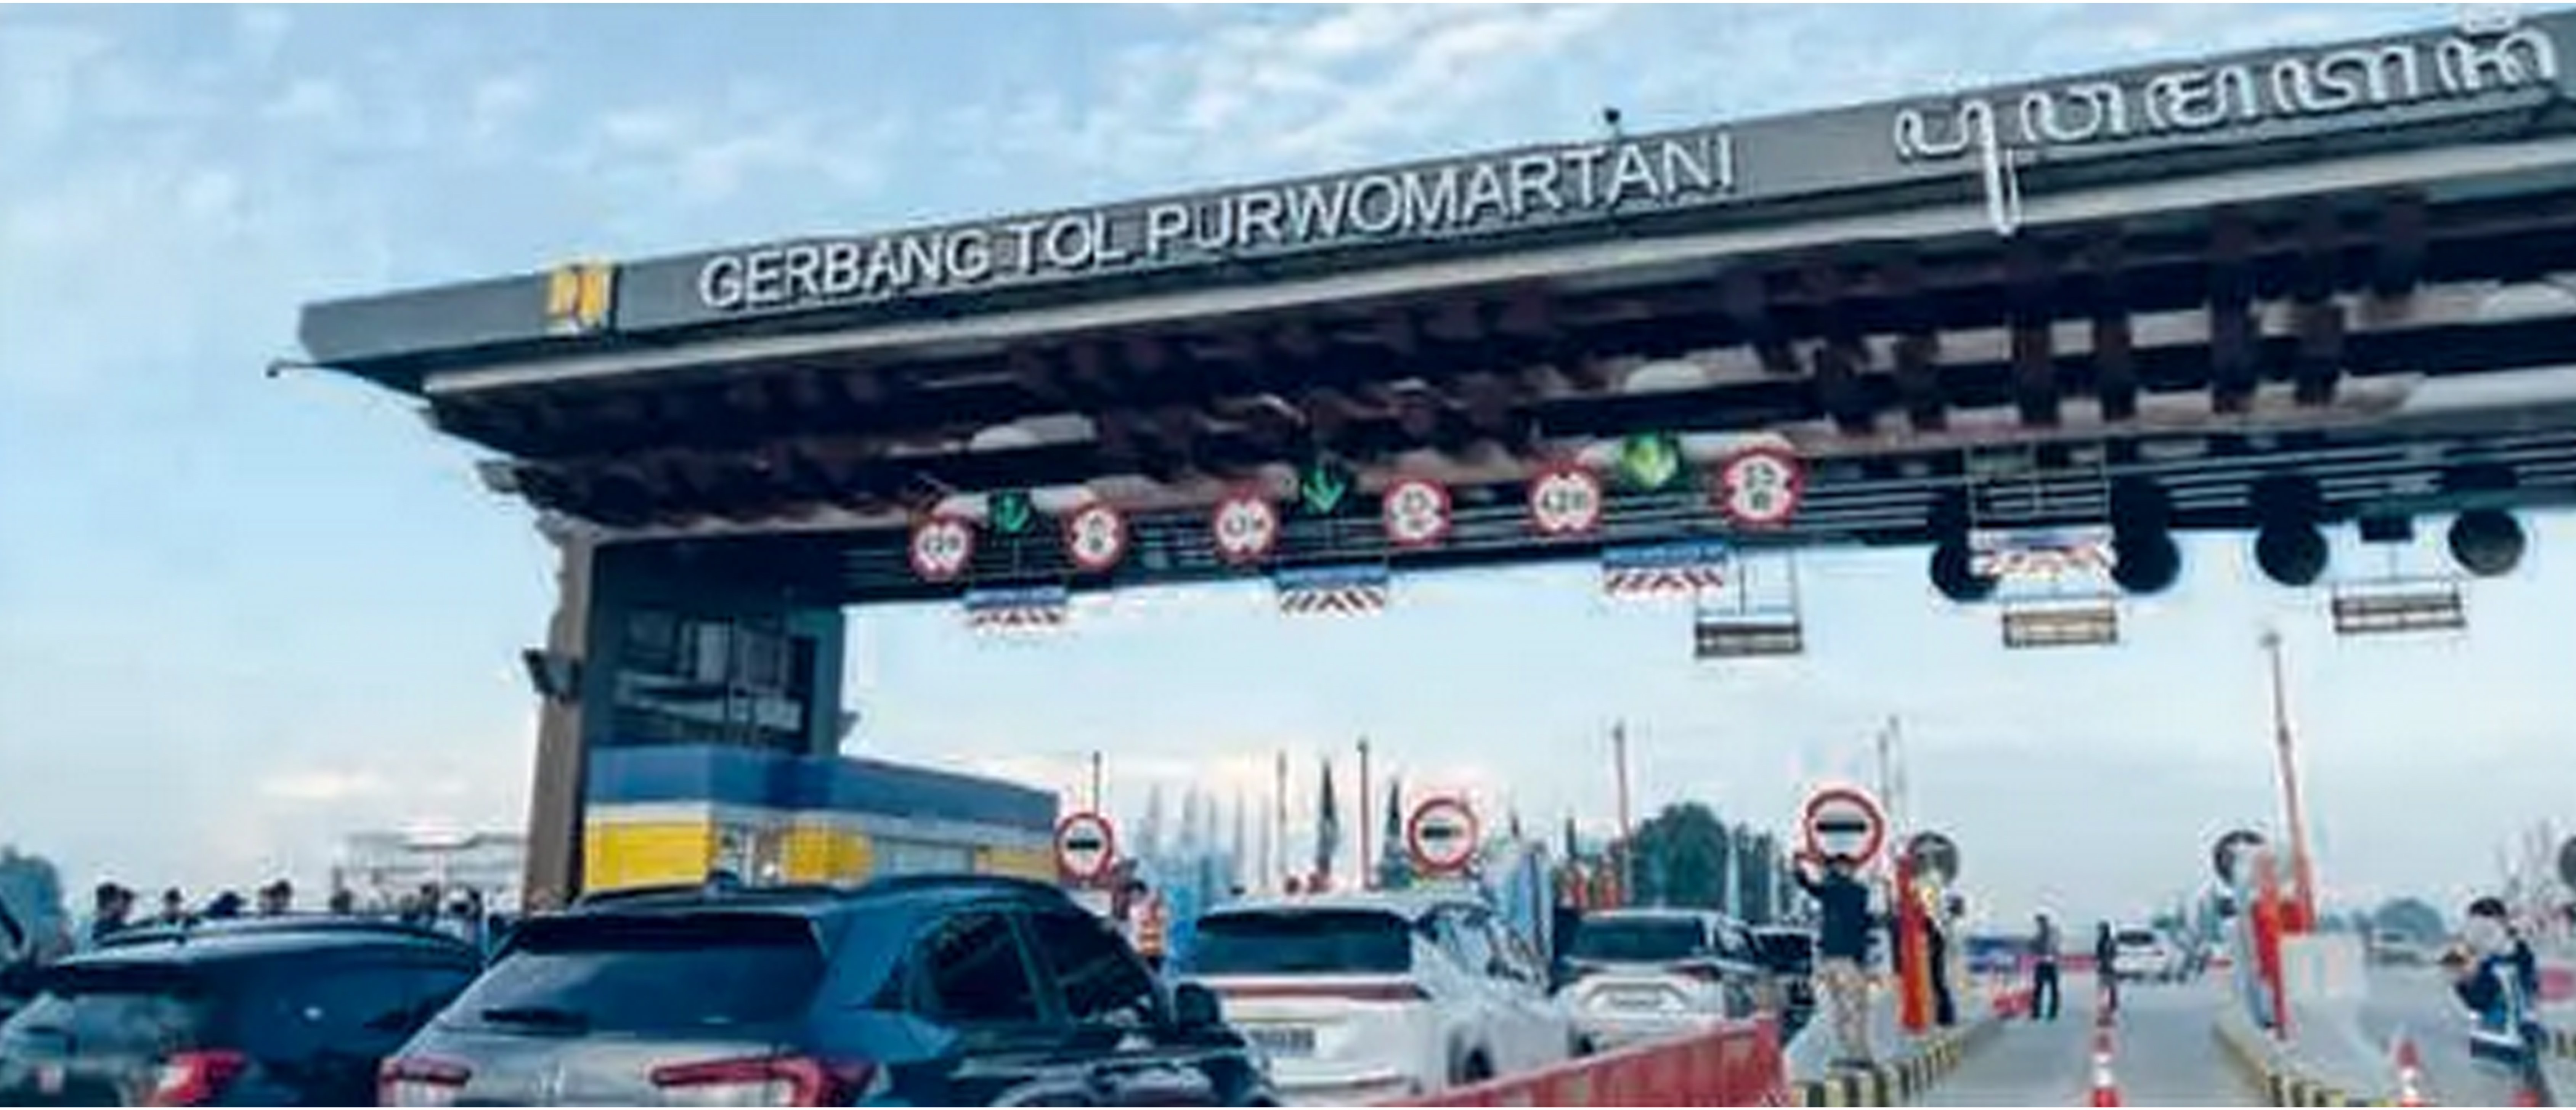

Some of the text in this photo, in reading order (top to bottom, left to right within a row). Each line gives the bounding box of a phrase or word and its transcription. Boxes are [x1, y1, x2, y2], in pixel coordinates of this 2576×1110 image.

[698, 133, 1734, 307] GERBANG TOL PURWOMARTANI
